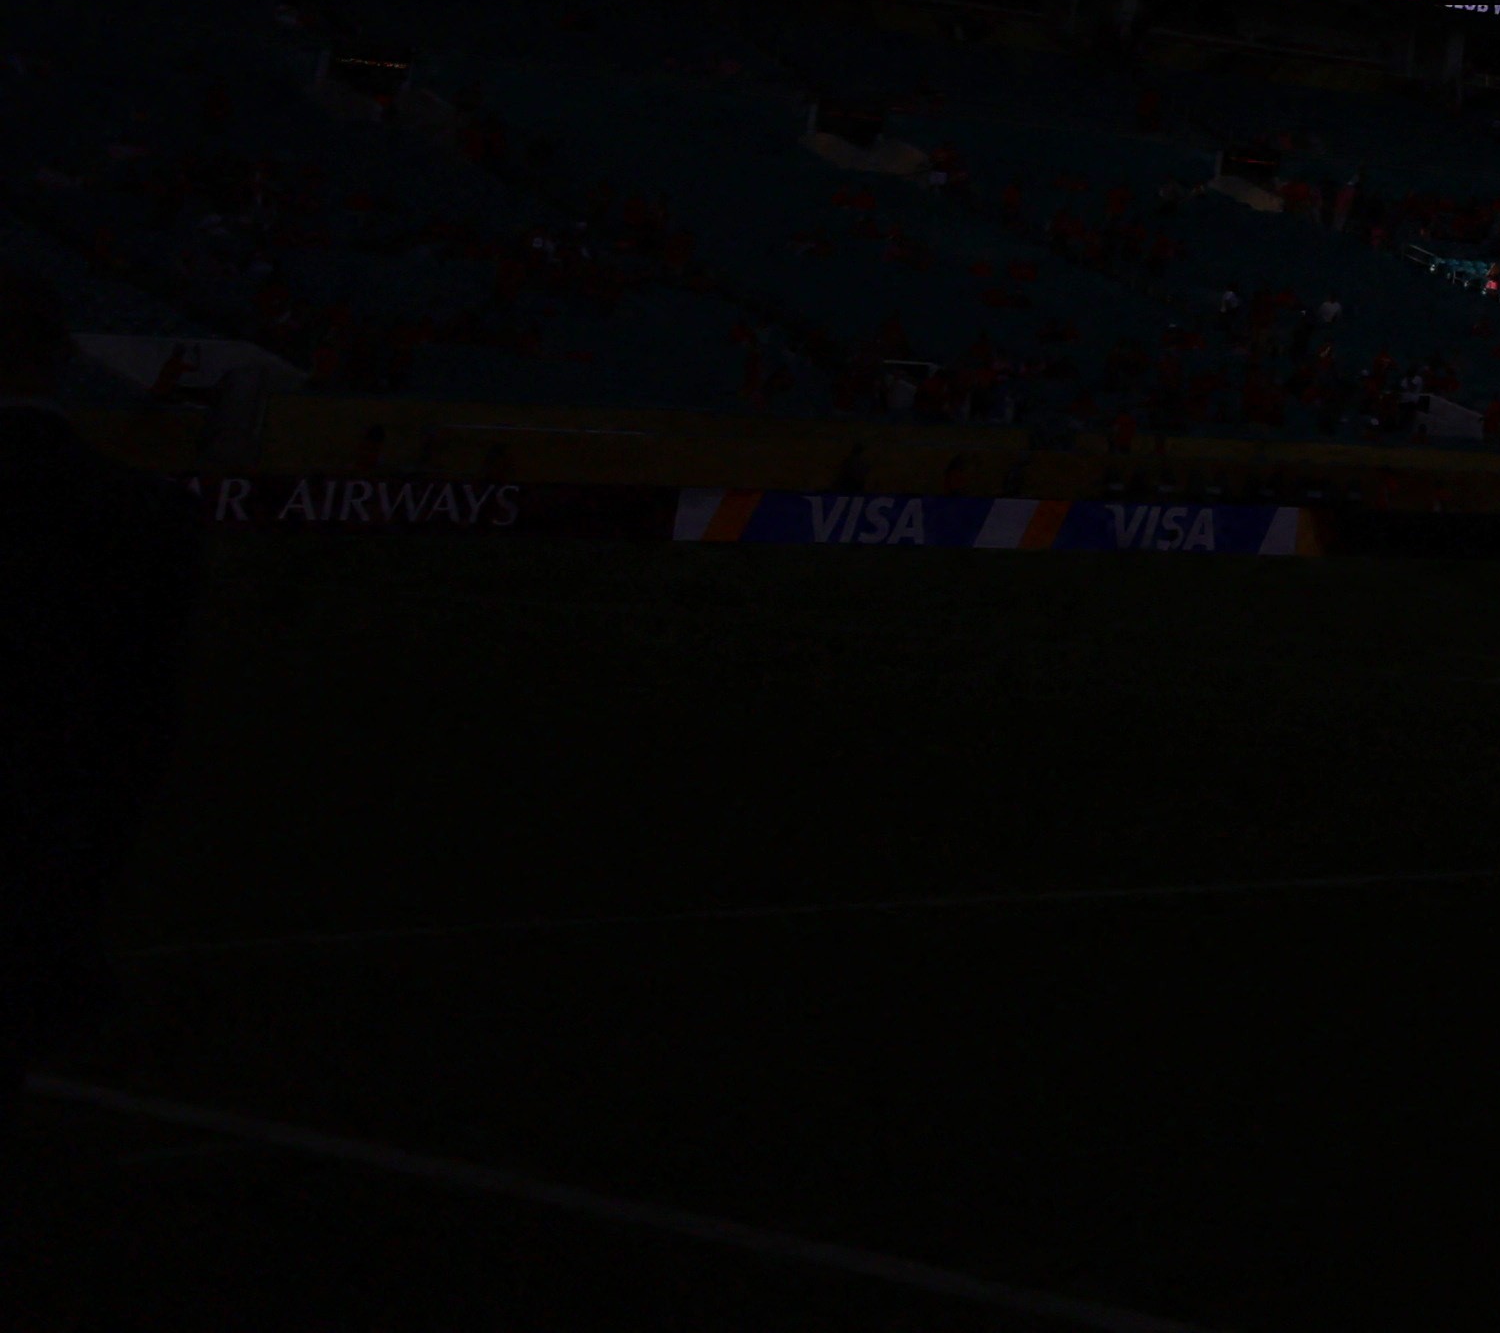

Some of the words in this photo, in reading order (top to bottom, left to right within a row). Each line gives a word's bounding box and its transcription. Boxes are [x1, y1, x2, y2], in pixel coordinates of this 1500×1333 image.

[278, 478, 520, 527] AIRWAYS
[801, 495, 926, 546] VISA
[1104, 505, 1217, 553] VISA
